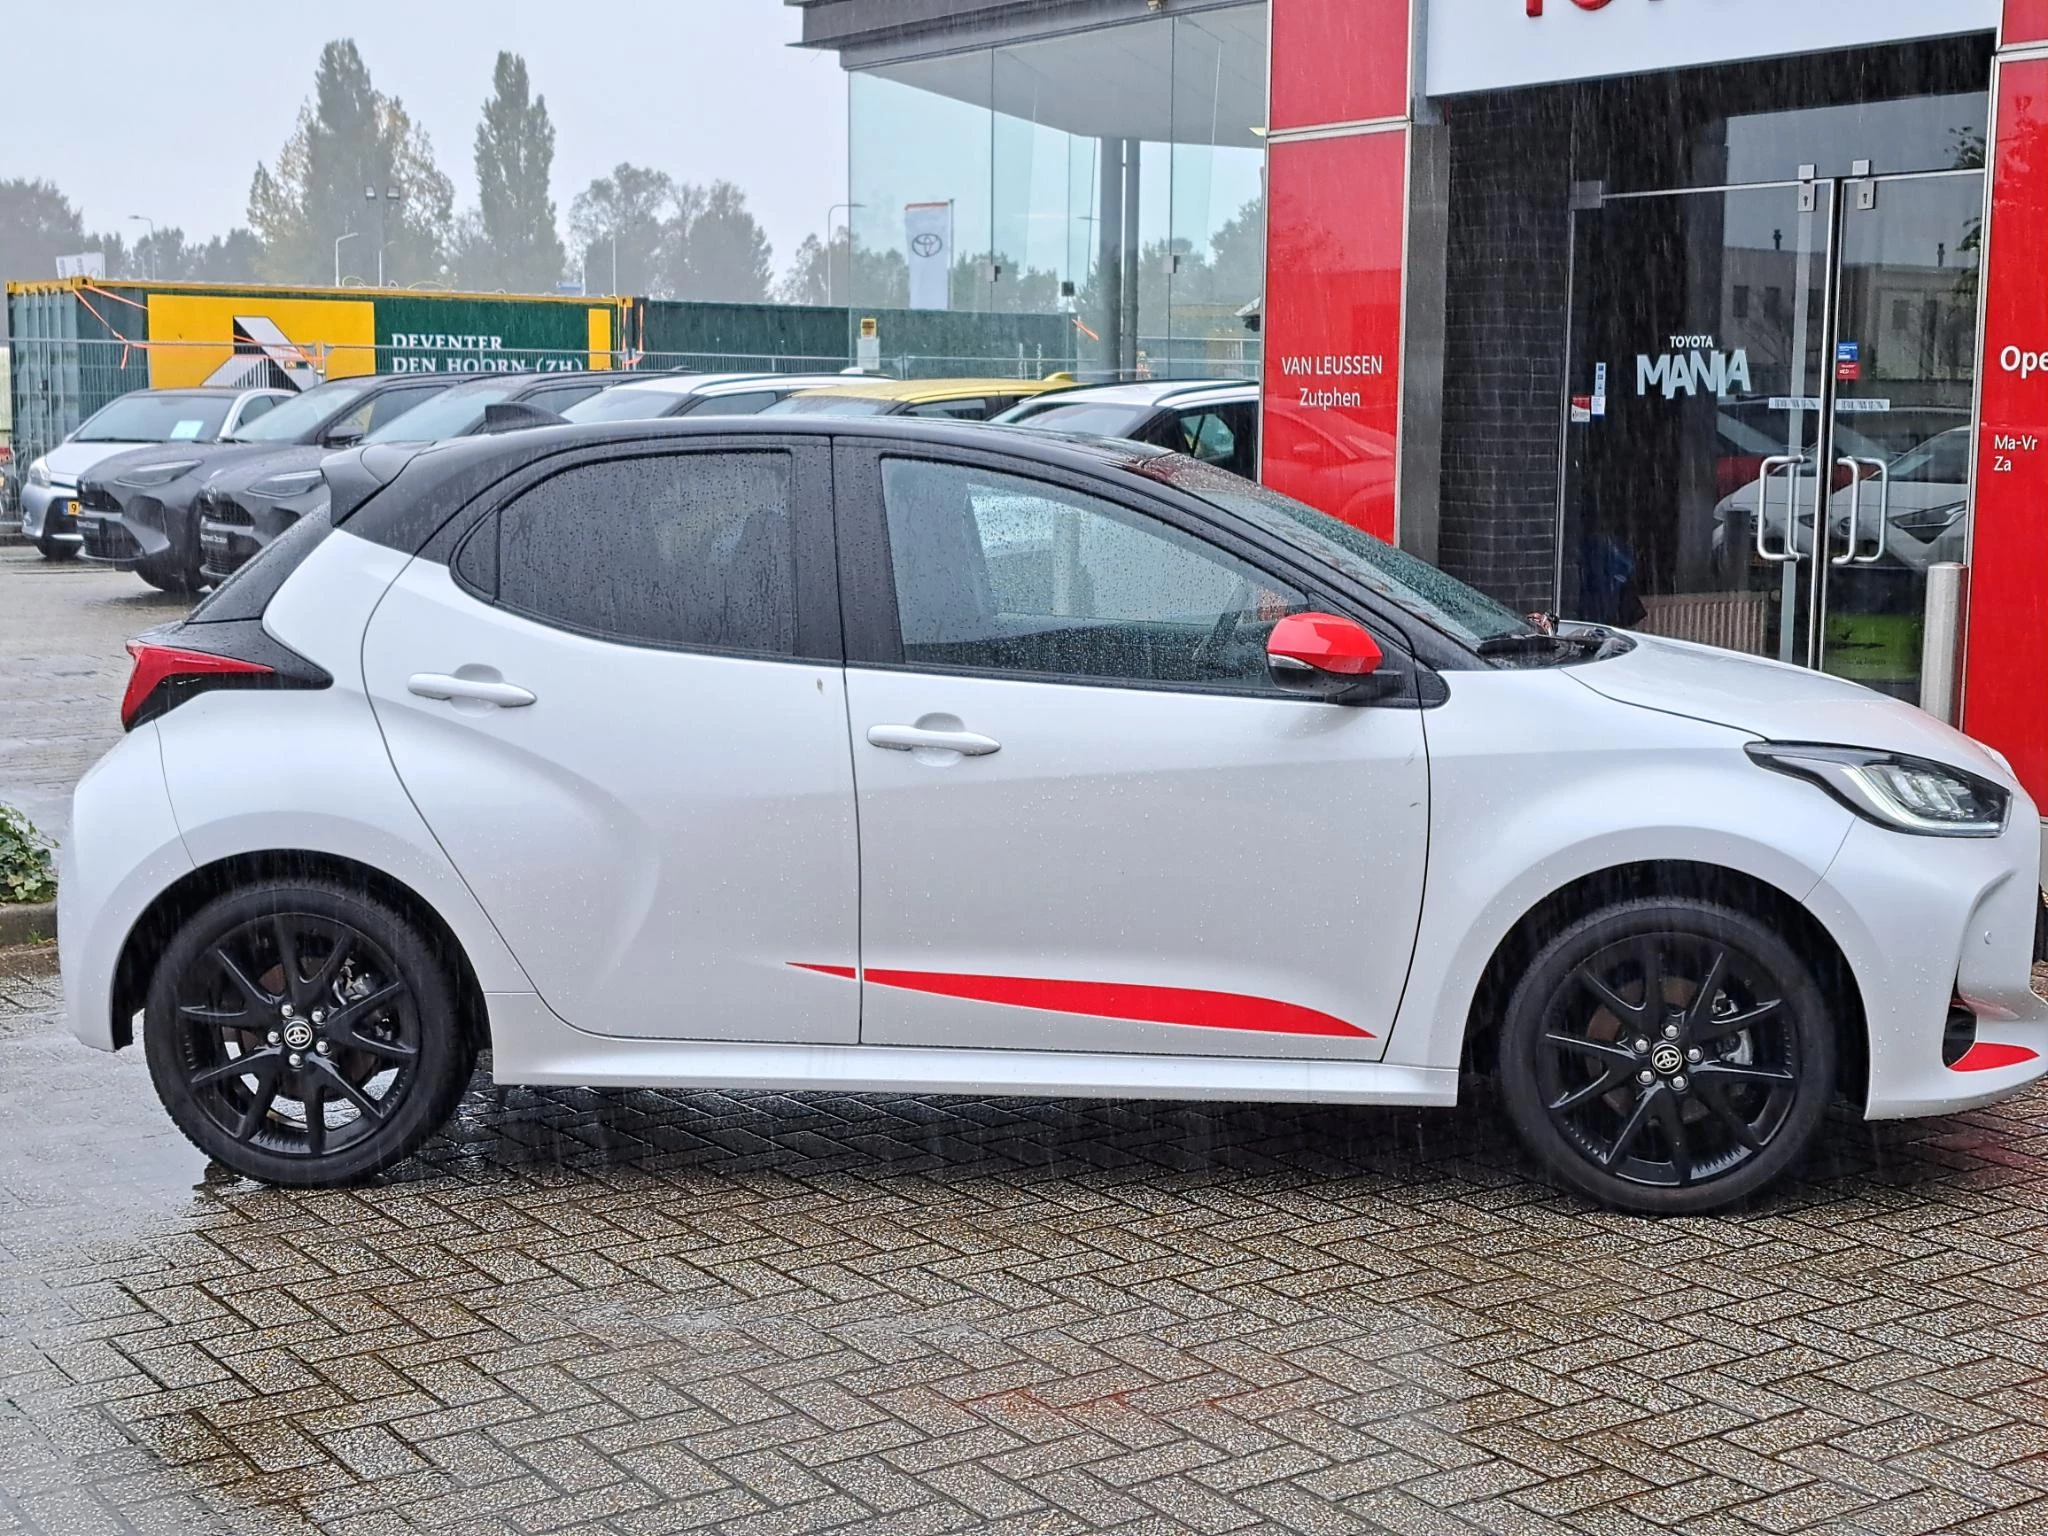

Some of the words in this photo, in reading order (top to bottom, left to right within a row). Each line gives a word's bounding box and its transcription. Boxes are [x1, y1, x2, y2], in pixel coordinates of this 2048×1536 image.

[391, 333, 502, 350] DEVENTER
[1669, 336, 1713, 348] TOYOTA
[391, 357, 436, 373] DEN
[446, 357, 526, 373] HOORN
[536, 357, 583, 372] (ZH)
[1281, 356, 1312, 375] VAN
[1316, 355, 1382, 375] LEUSSEN
[1637, 348, 1751, 399] MANIA
[1299, 387, 1360, 411] Zutphen
[1994, 434, 2038, 451] Ma-Vr
[1993, 455, 2012, 471] Za
